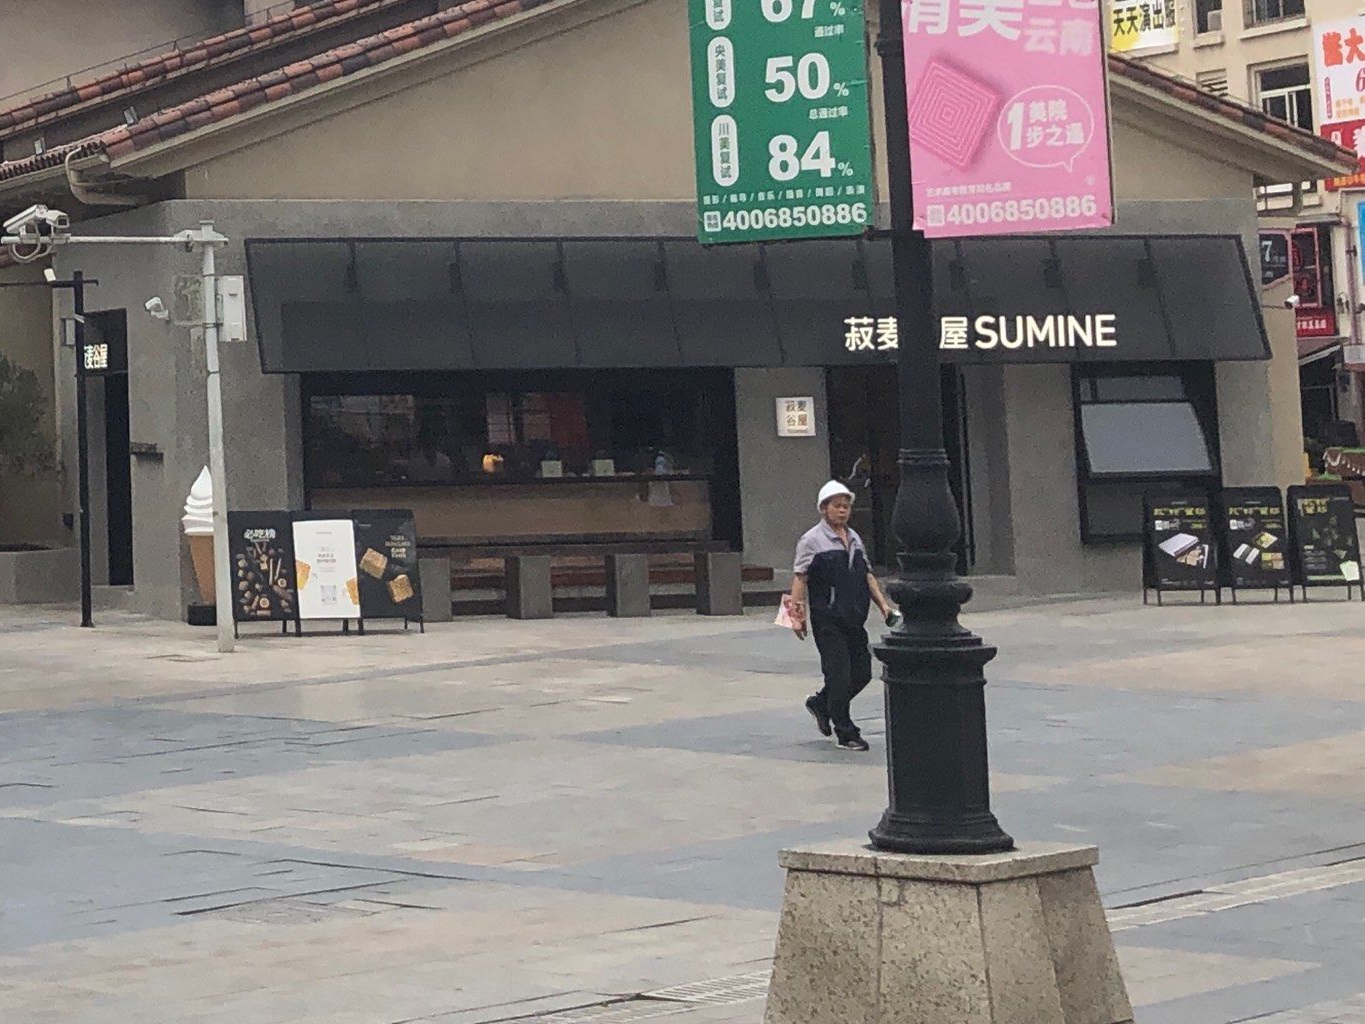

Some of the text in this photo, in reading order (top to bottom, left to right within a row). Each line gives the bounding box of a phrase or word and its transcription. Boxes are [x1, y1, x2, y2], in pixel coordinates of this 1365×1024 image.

[723, 202, 867, 231] 4006850886
[947, 194, 1097, 225] 4006850886
[975, 314, 1118, 350] SUMINE
